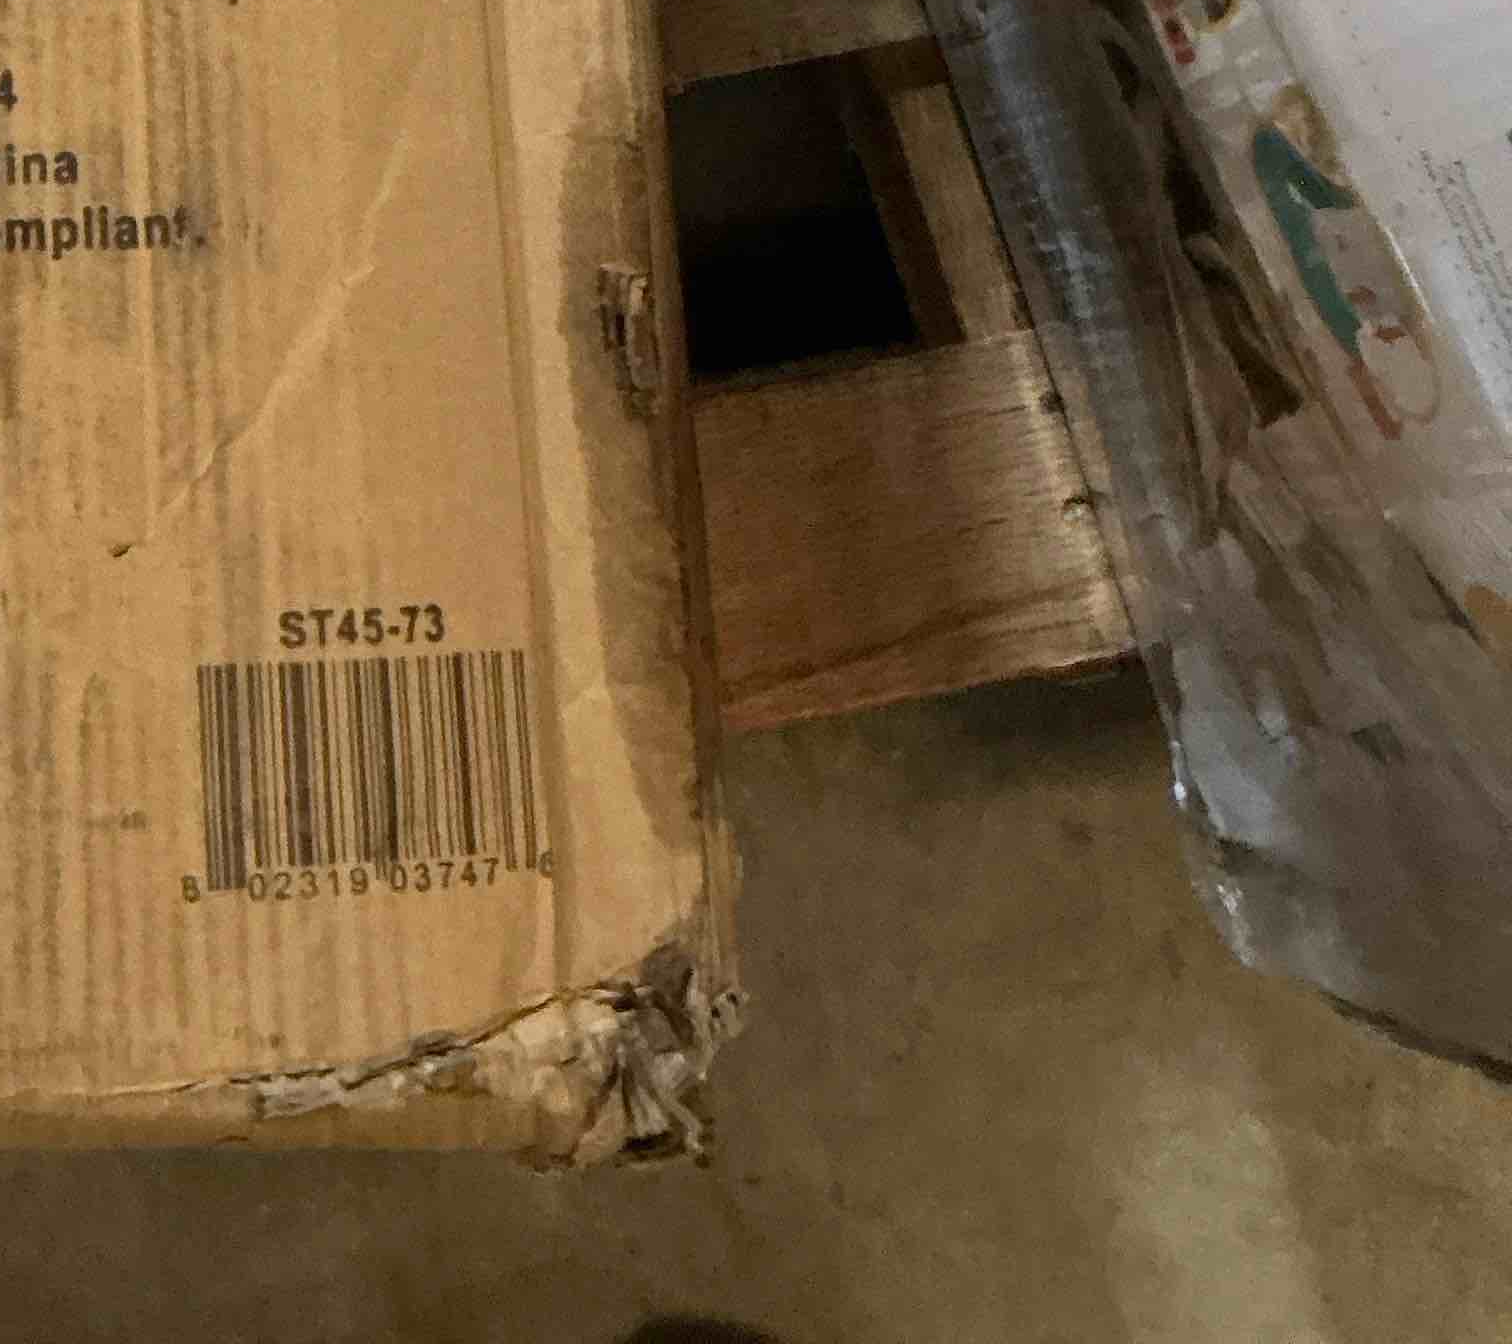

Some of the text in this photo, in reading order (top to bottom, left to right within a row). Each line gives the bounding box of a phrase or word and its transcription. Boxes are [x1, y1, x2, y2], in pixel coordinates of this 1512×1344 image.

[279, 604, 445, 649] ST45-73
[248, 868, 369, 903] 02319
[390, 857, 499, 892] 03747
